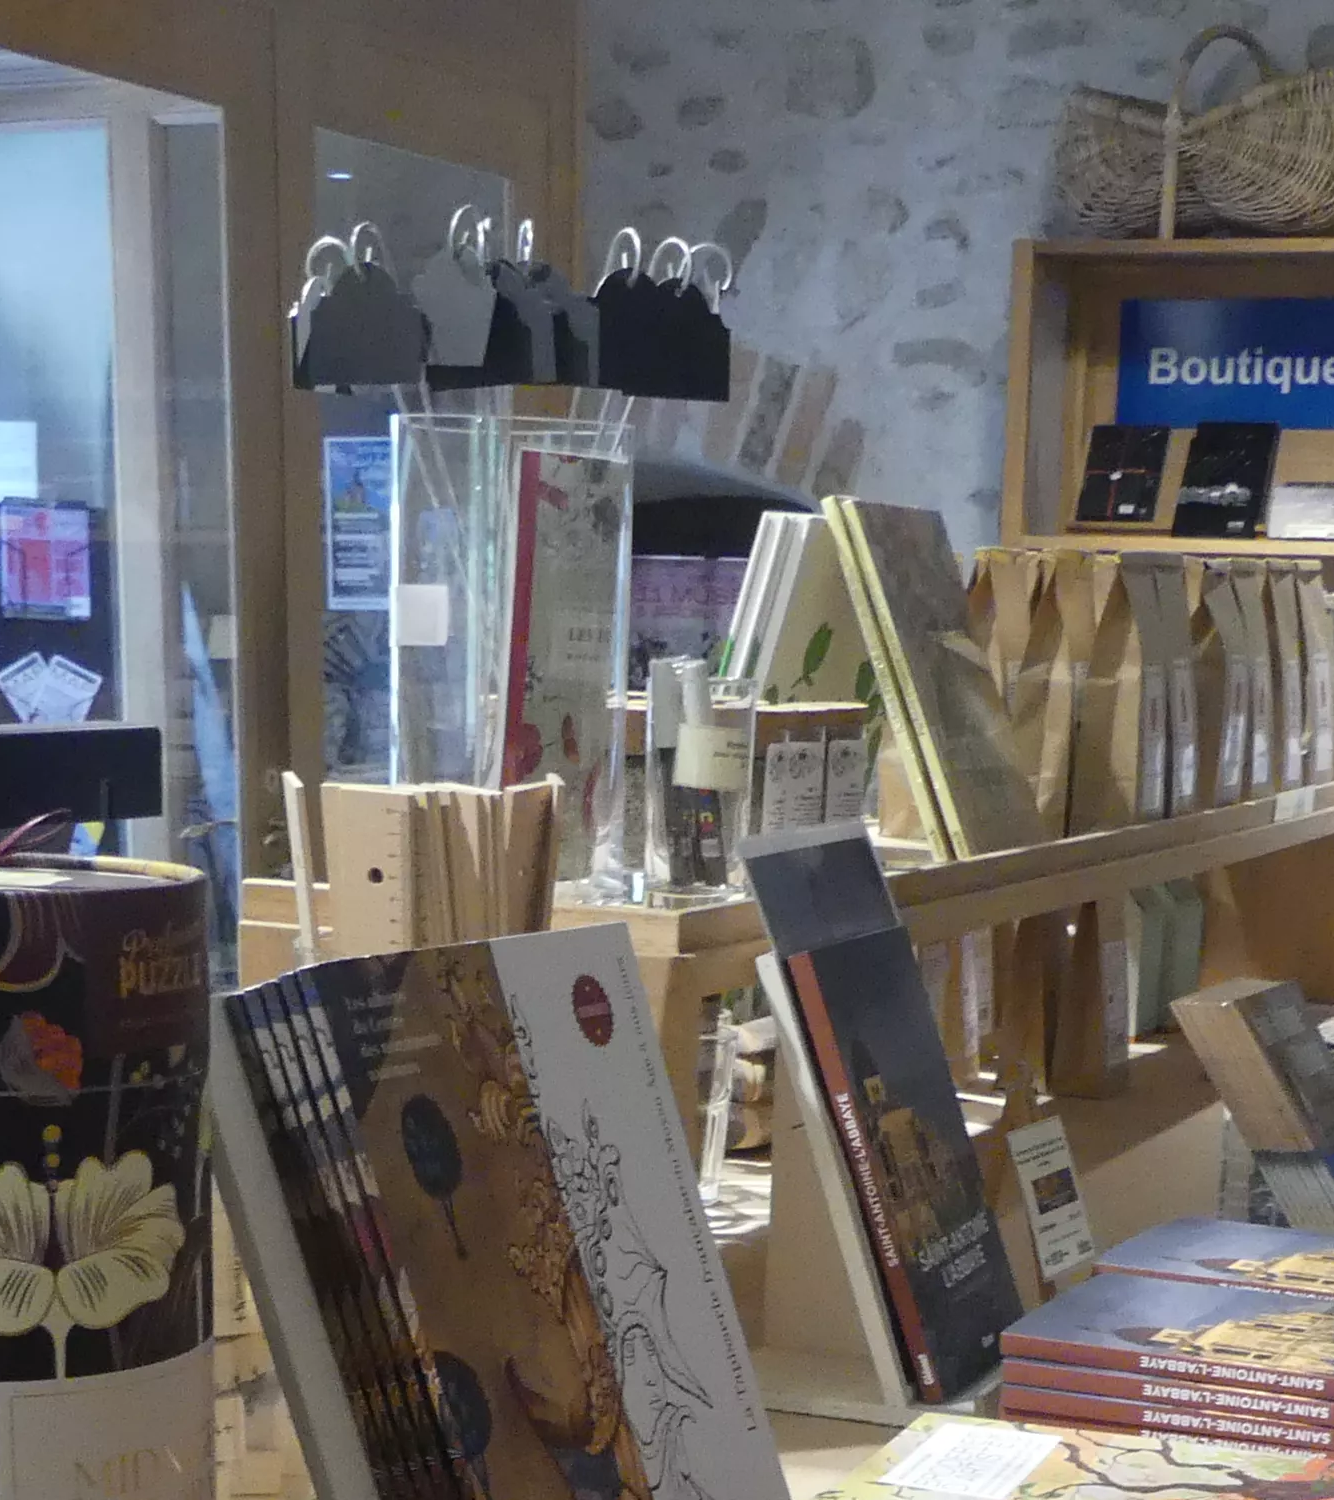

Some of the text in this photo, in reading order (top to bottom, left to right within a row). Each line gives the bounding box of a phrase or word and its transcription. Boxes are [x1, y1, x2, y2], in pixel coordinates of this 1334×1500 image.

[1139, 1355, 1325, 1391] SAINT-ANTOINE-L'ABBAYE
[1142, 1383, 1329, 1419] SAINT-ANTOINE-L'ABBAYE
[1142, 1410, 1331, 1445] SAINT-ANTOINE-L'ABBAYE
